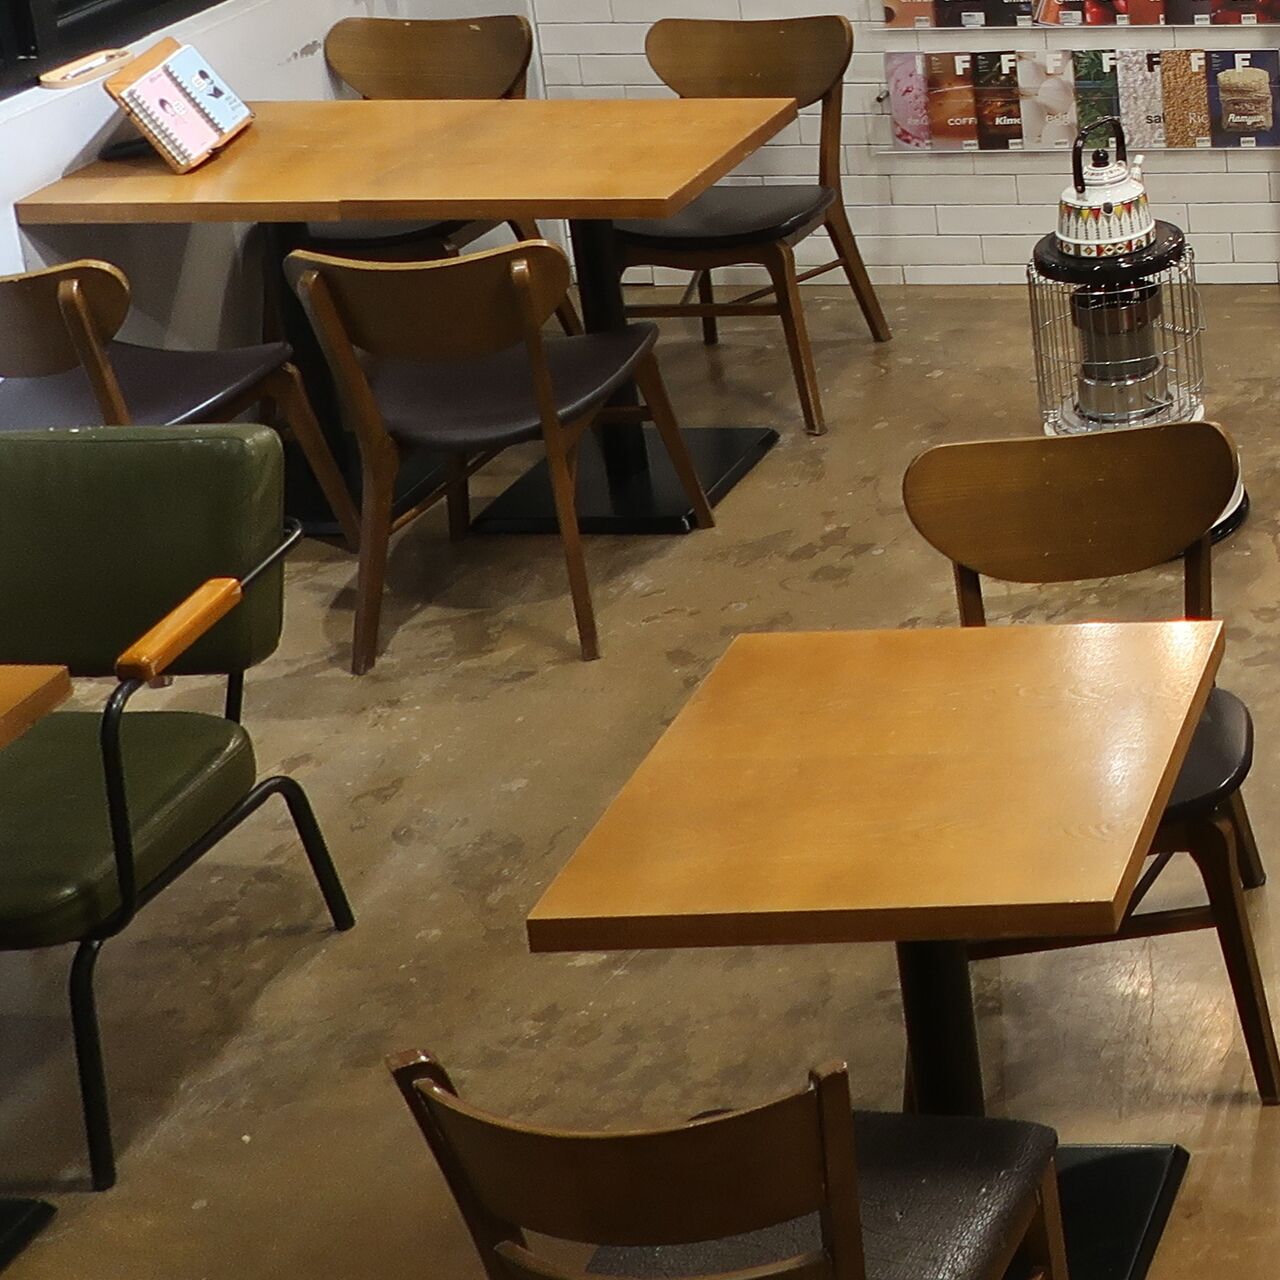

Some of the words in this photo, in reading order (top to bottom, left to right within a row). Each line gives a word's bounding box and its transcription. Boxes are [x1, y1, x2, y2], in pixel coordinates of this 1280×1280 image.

[954, 55, 971, 75] F
[1000, 54, 1016, 74] F
[1046, 54, 1062, 74] F
[1101, 52, 1117, 73] F
[1234, 53, 1251, 73] F
